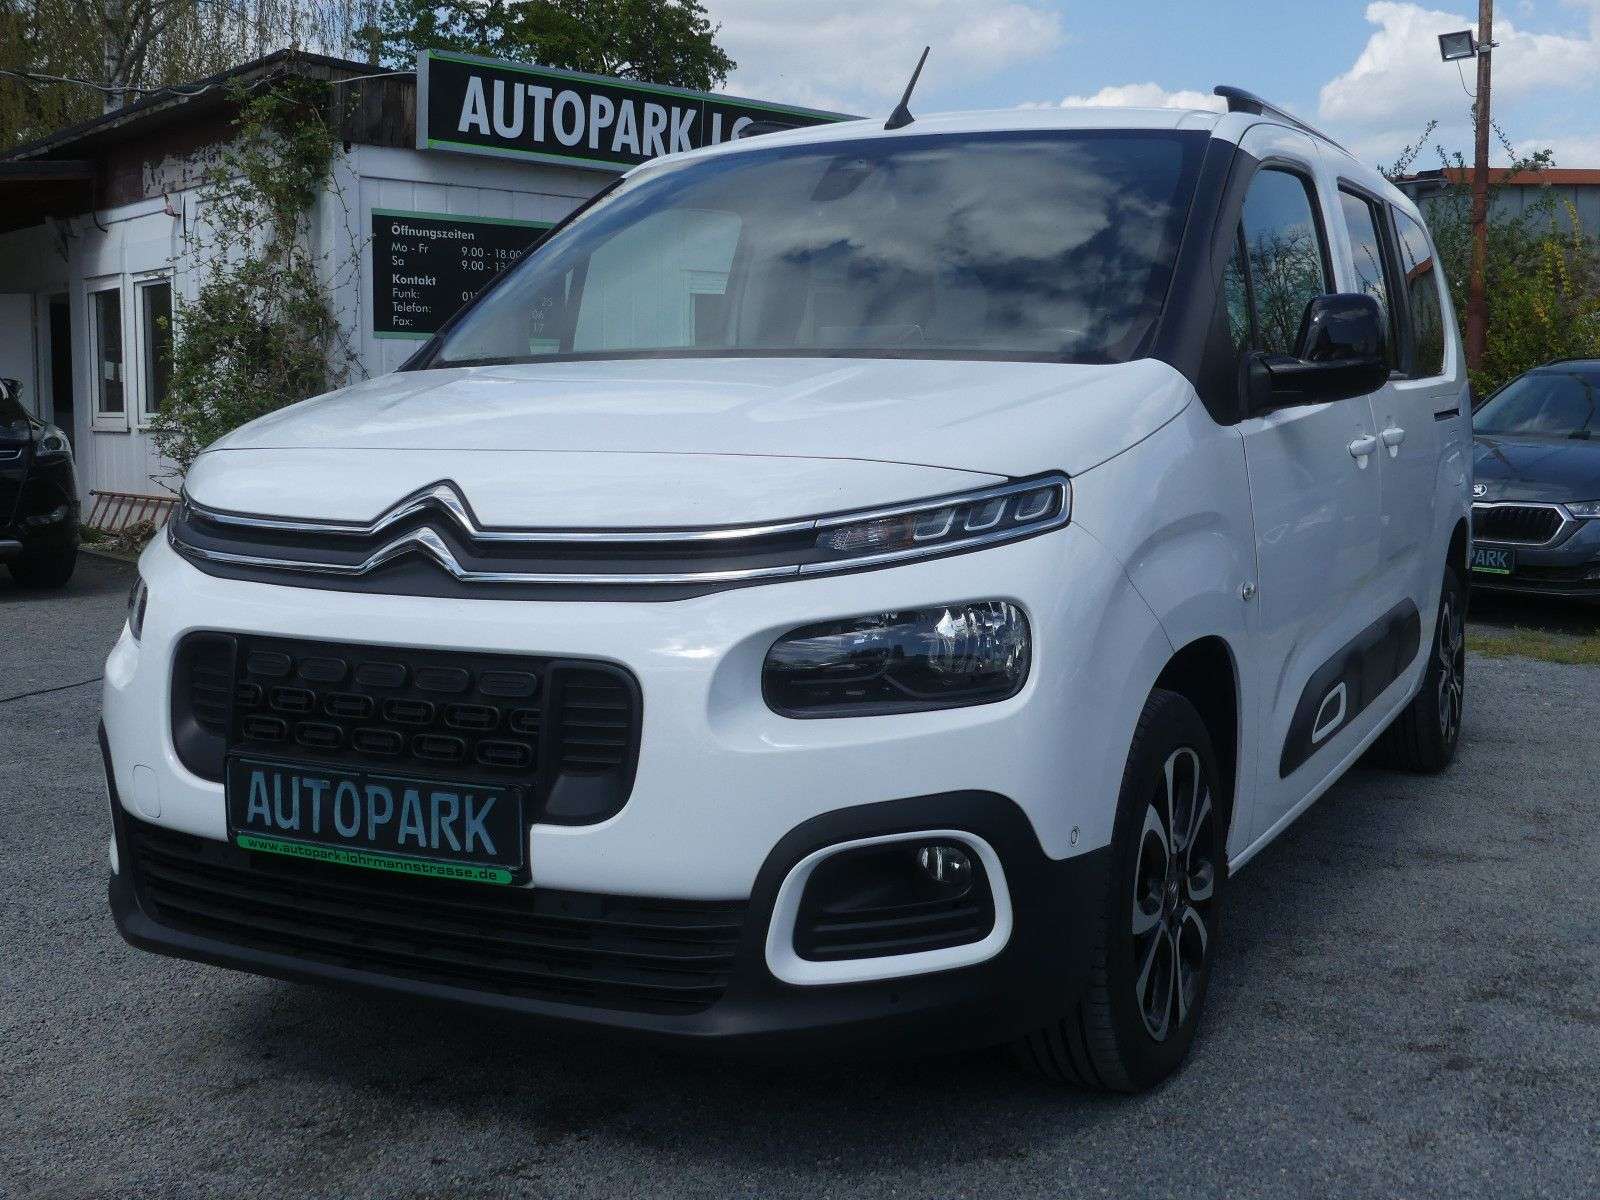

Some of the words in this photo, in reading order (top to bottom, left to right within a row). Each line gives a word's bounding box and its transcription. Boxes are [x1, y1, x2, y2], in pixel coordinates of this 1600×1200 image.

[457, 76, 697, 158] AUTOPARK
[391, 222, 475, 240] Öffnungszeiten
[391, 242, 408, 253] Mo
[419, 243, 429, 254] Fr
[461, 246, 484, 257] 9.00
[392, 256, 405, 266] Sa
[461, 260, 484, 271] 9.00
[392, 274, 436, 286] Kontakt
[392, 287, 420, 299] Funk:
[392, 301, 432, 313] Telefon:
[392, 315, 413, 326] Fax:
[246, 771, 498, 856] AUTOPARK
[247, 837, 498, 881] www.autopark-lohrmannstrasse.de
